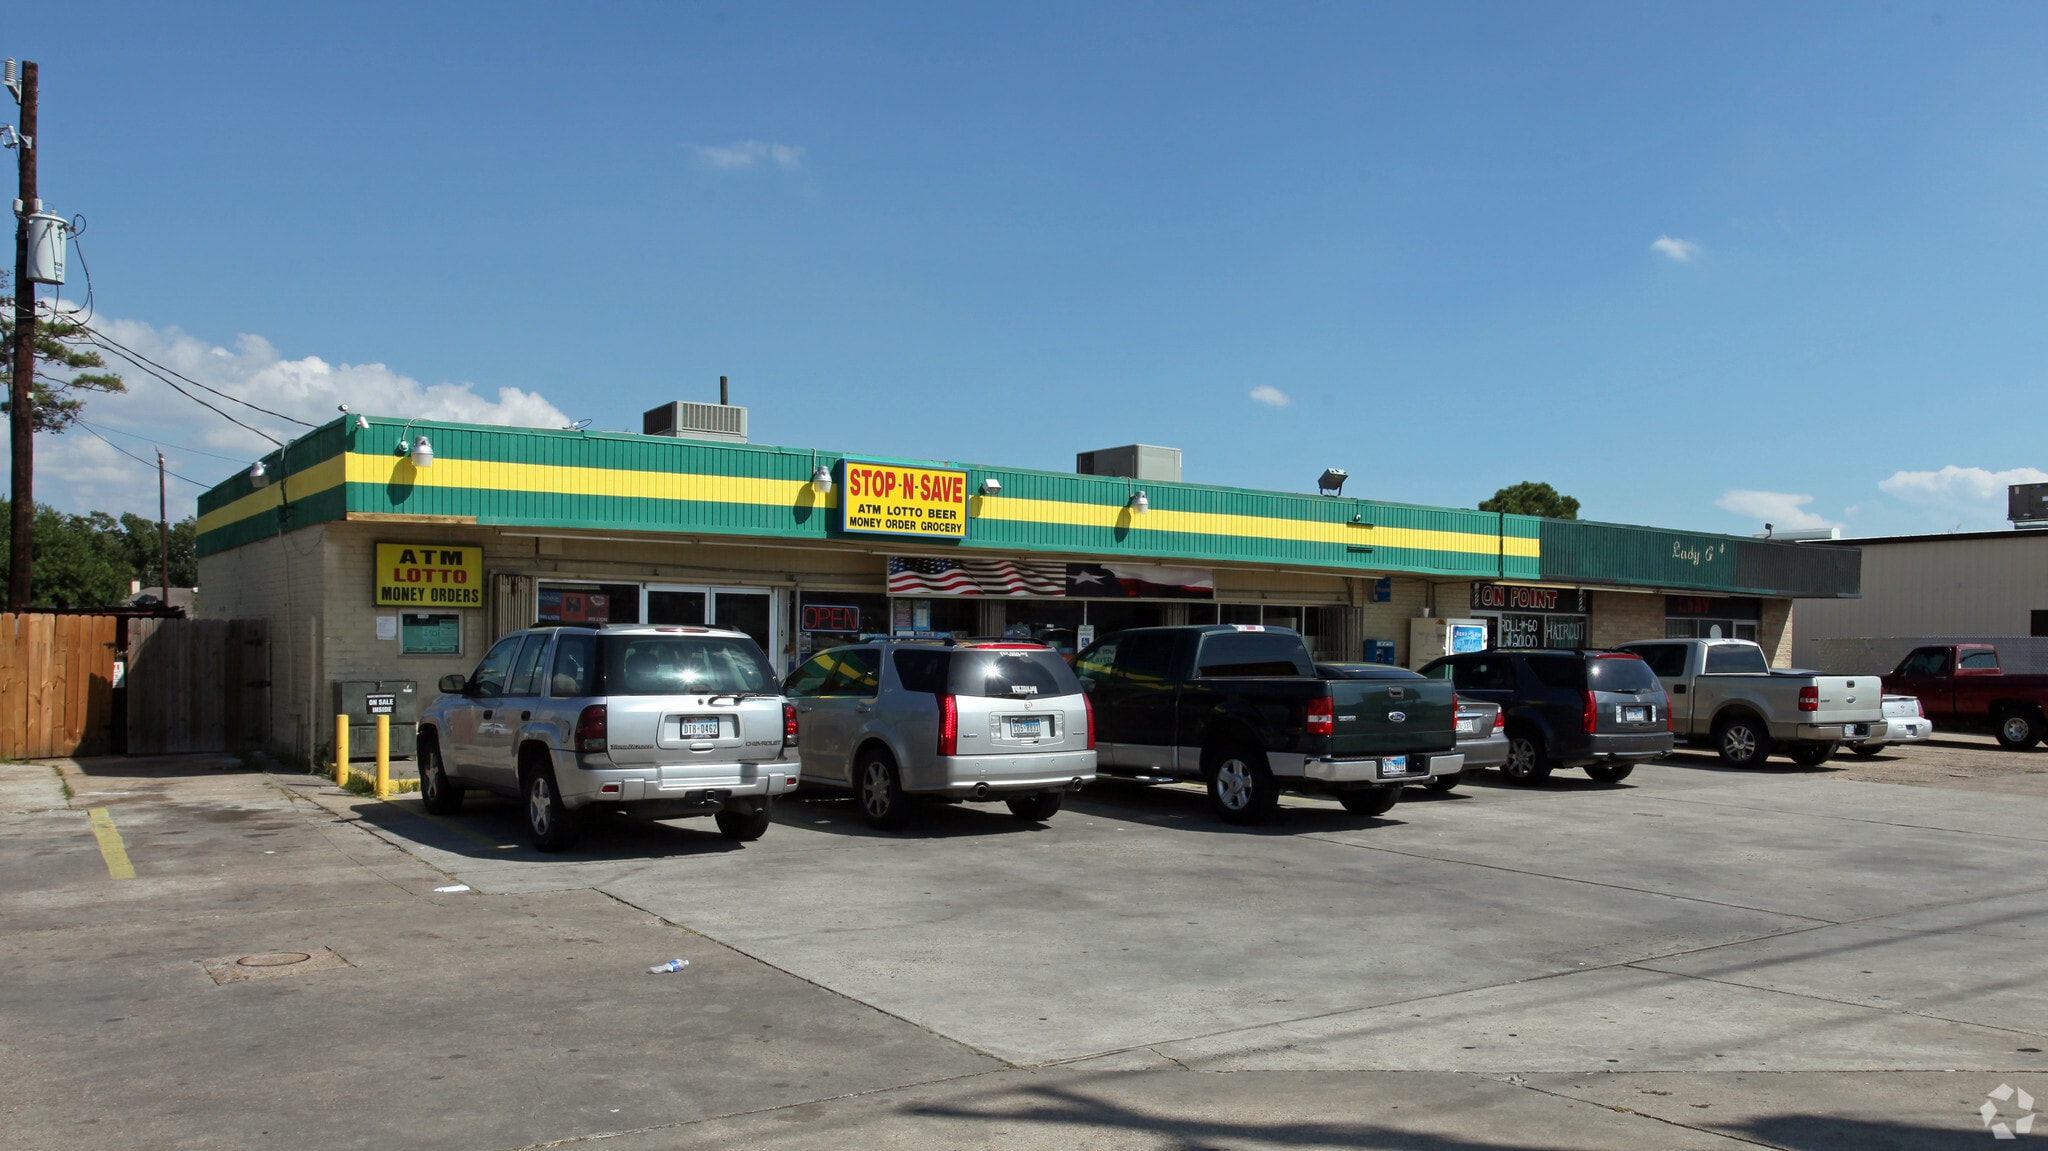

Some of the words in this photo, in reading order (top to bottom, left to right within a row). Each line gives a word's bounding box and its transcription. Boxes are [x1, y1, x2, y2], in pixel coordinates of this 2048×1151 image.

[858, 504, 881, 514] ATM
[887, 506, 923, 517] LOTTO
[928, 508, 957, 519] BEER
[849, 516, 882, 528] MONEY
[885, 519, 916, 530] ORDER
[921, 522, 962, 533] GROCERY
[400, 549, 463, 565] ATM
[1672, 540, 1700, 566] Lady
[394, 568, 467, 583] LOTTO
[381, 586, 425, 601] MONEY
[431, 588, 479, 603] ORDERS
[1482, 586, 1504, 606] ON
[1510, 587, 1558, 609] POINT
[804, 607, 857, 630] OPEN
[1546, 622, 1585, 640] HAIRCUT
